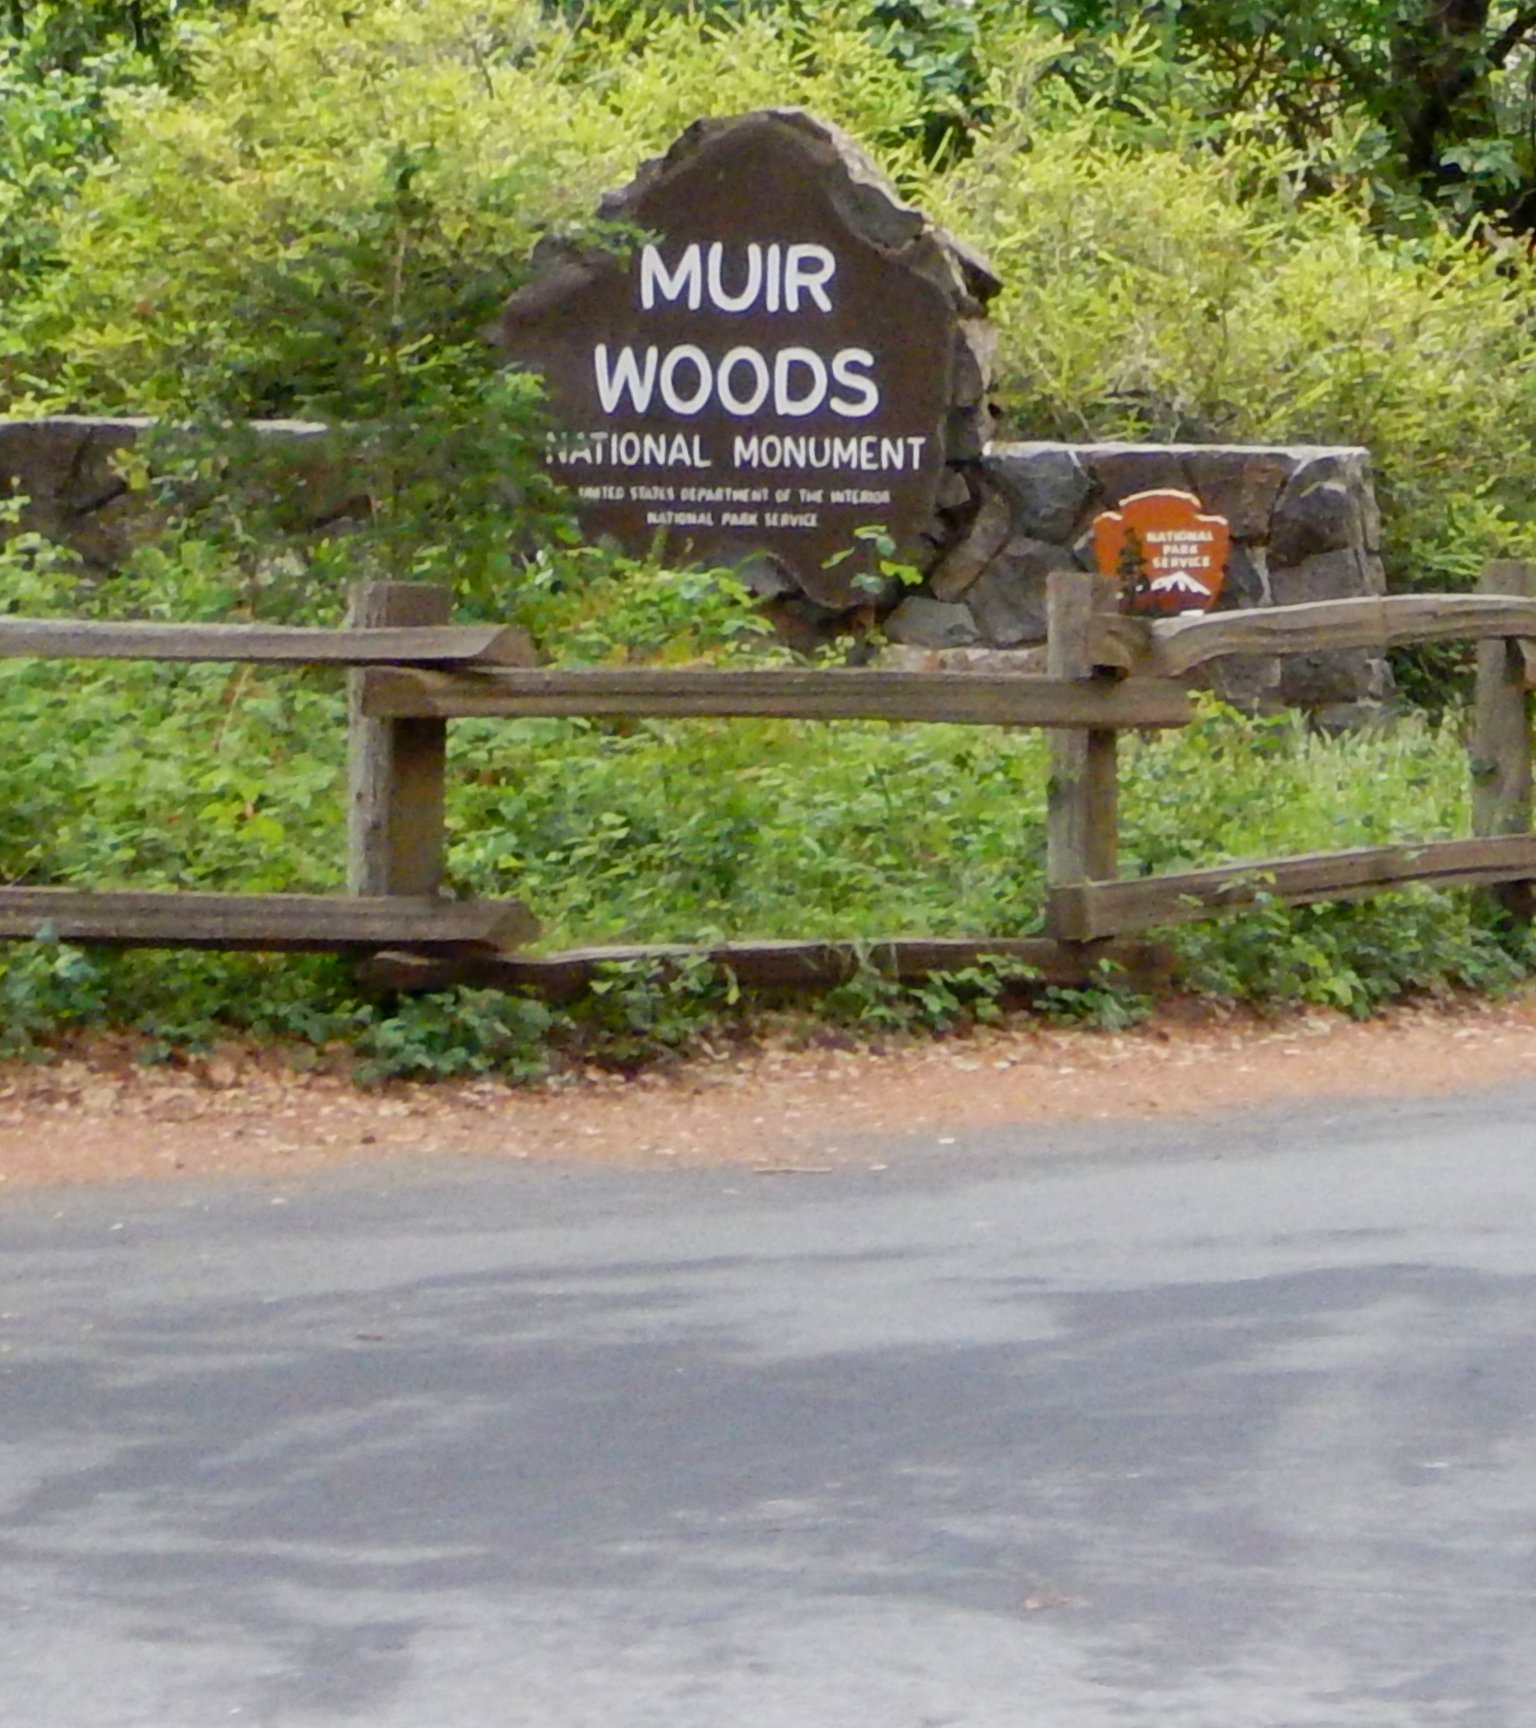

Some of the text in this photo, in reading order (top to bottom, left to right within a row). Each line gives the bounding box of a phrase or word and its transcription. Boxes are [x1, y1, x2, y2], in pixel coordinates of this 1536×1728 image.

[640, 242, 837, 313] MUIR
[594, 343, 880, 418] WOODS
[733, 435, 927, 471] MONUMENT
[630, 485, 675, 501] STATES
[680, 487, 769, 503] DEPARTMENT
[775, 487, 791, 503] OF
[799, 487, 824, 503] THE
[830, 488, 891, 504] INTERIOR
[647, 510, 818, 528] NATIONAL PARK SERVICE
[1146, 531, 1214, 543] NATIONAL
[1162, 544, 1199, 555] PARK
[1152, 556, 1211, 568] SERVICE
